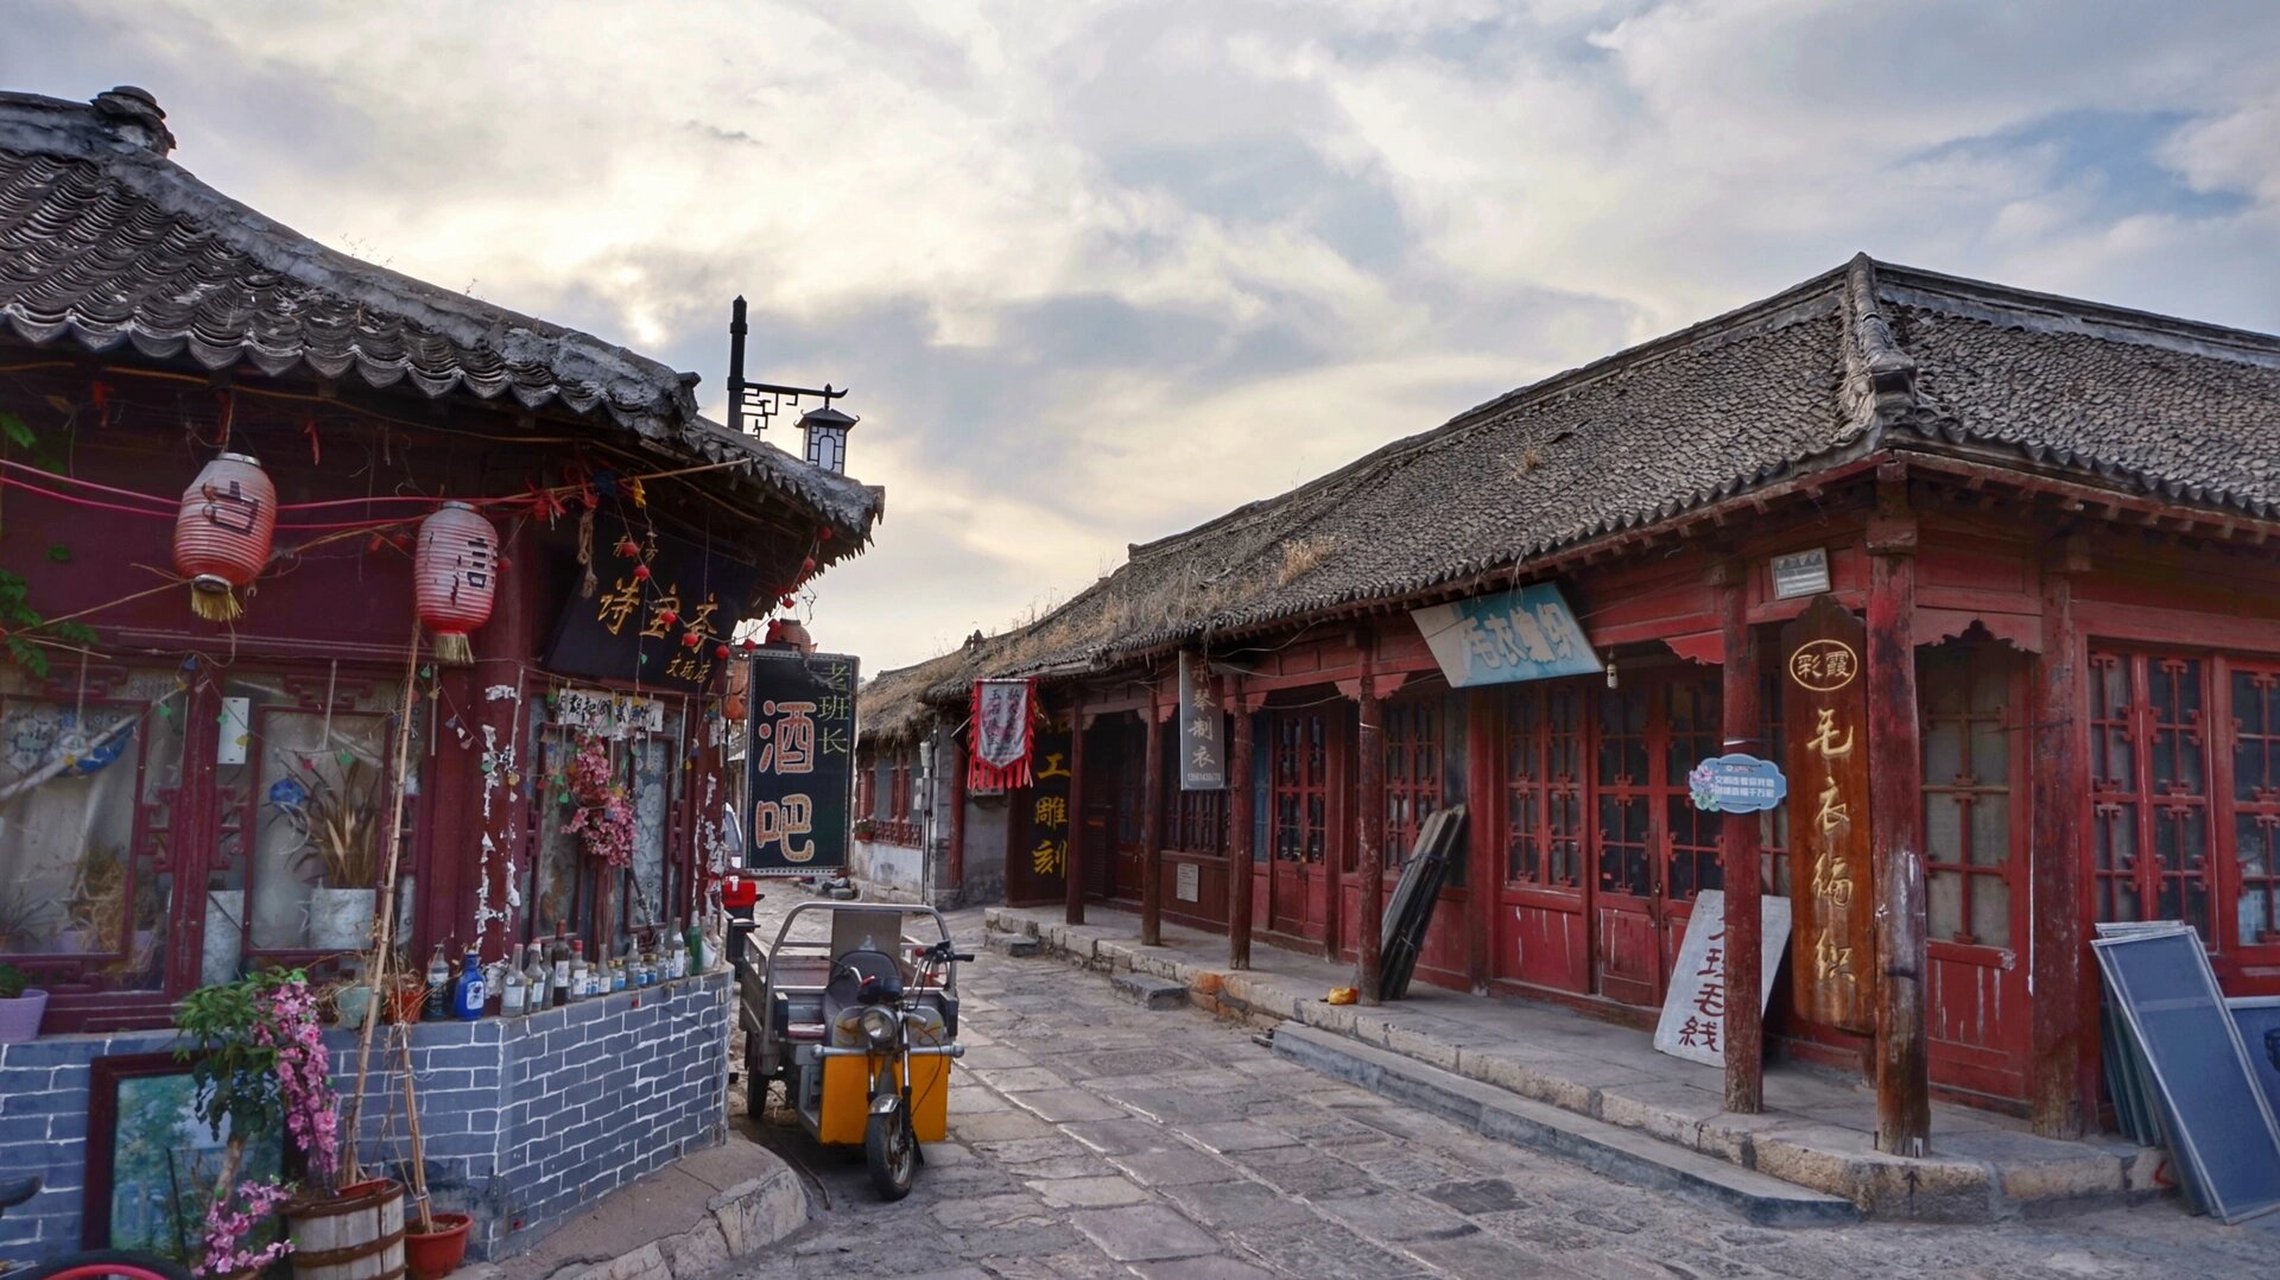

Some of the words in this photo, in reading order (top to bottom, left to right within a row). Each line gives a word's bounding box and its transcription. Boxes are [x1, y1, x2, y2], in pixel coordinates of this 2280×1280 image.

[815, 662, 851, 755] 老班长
[1797, 650, 1851, 678] 彩霞
[756, 700, 817, 863] 酒吧
[1032, 719, 1072, 880] 工雕刻
[1807, 707, 1856, 983] 毛衣编织
